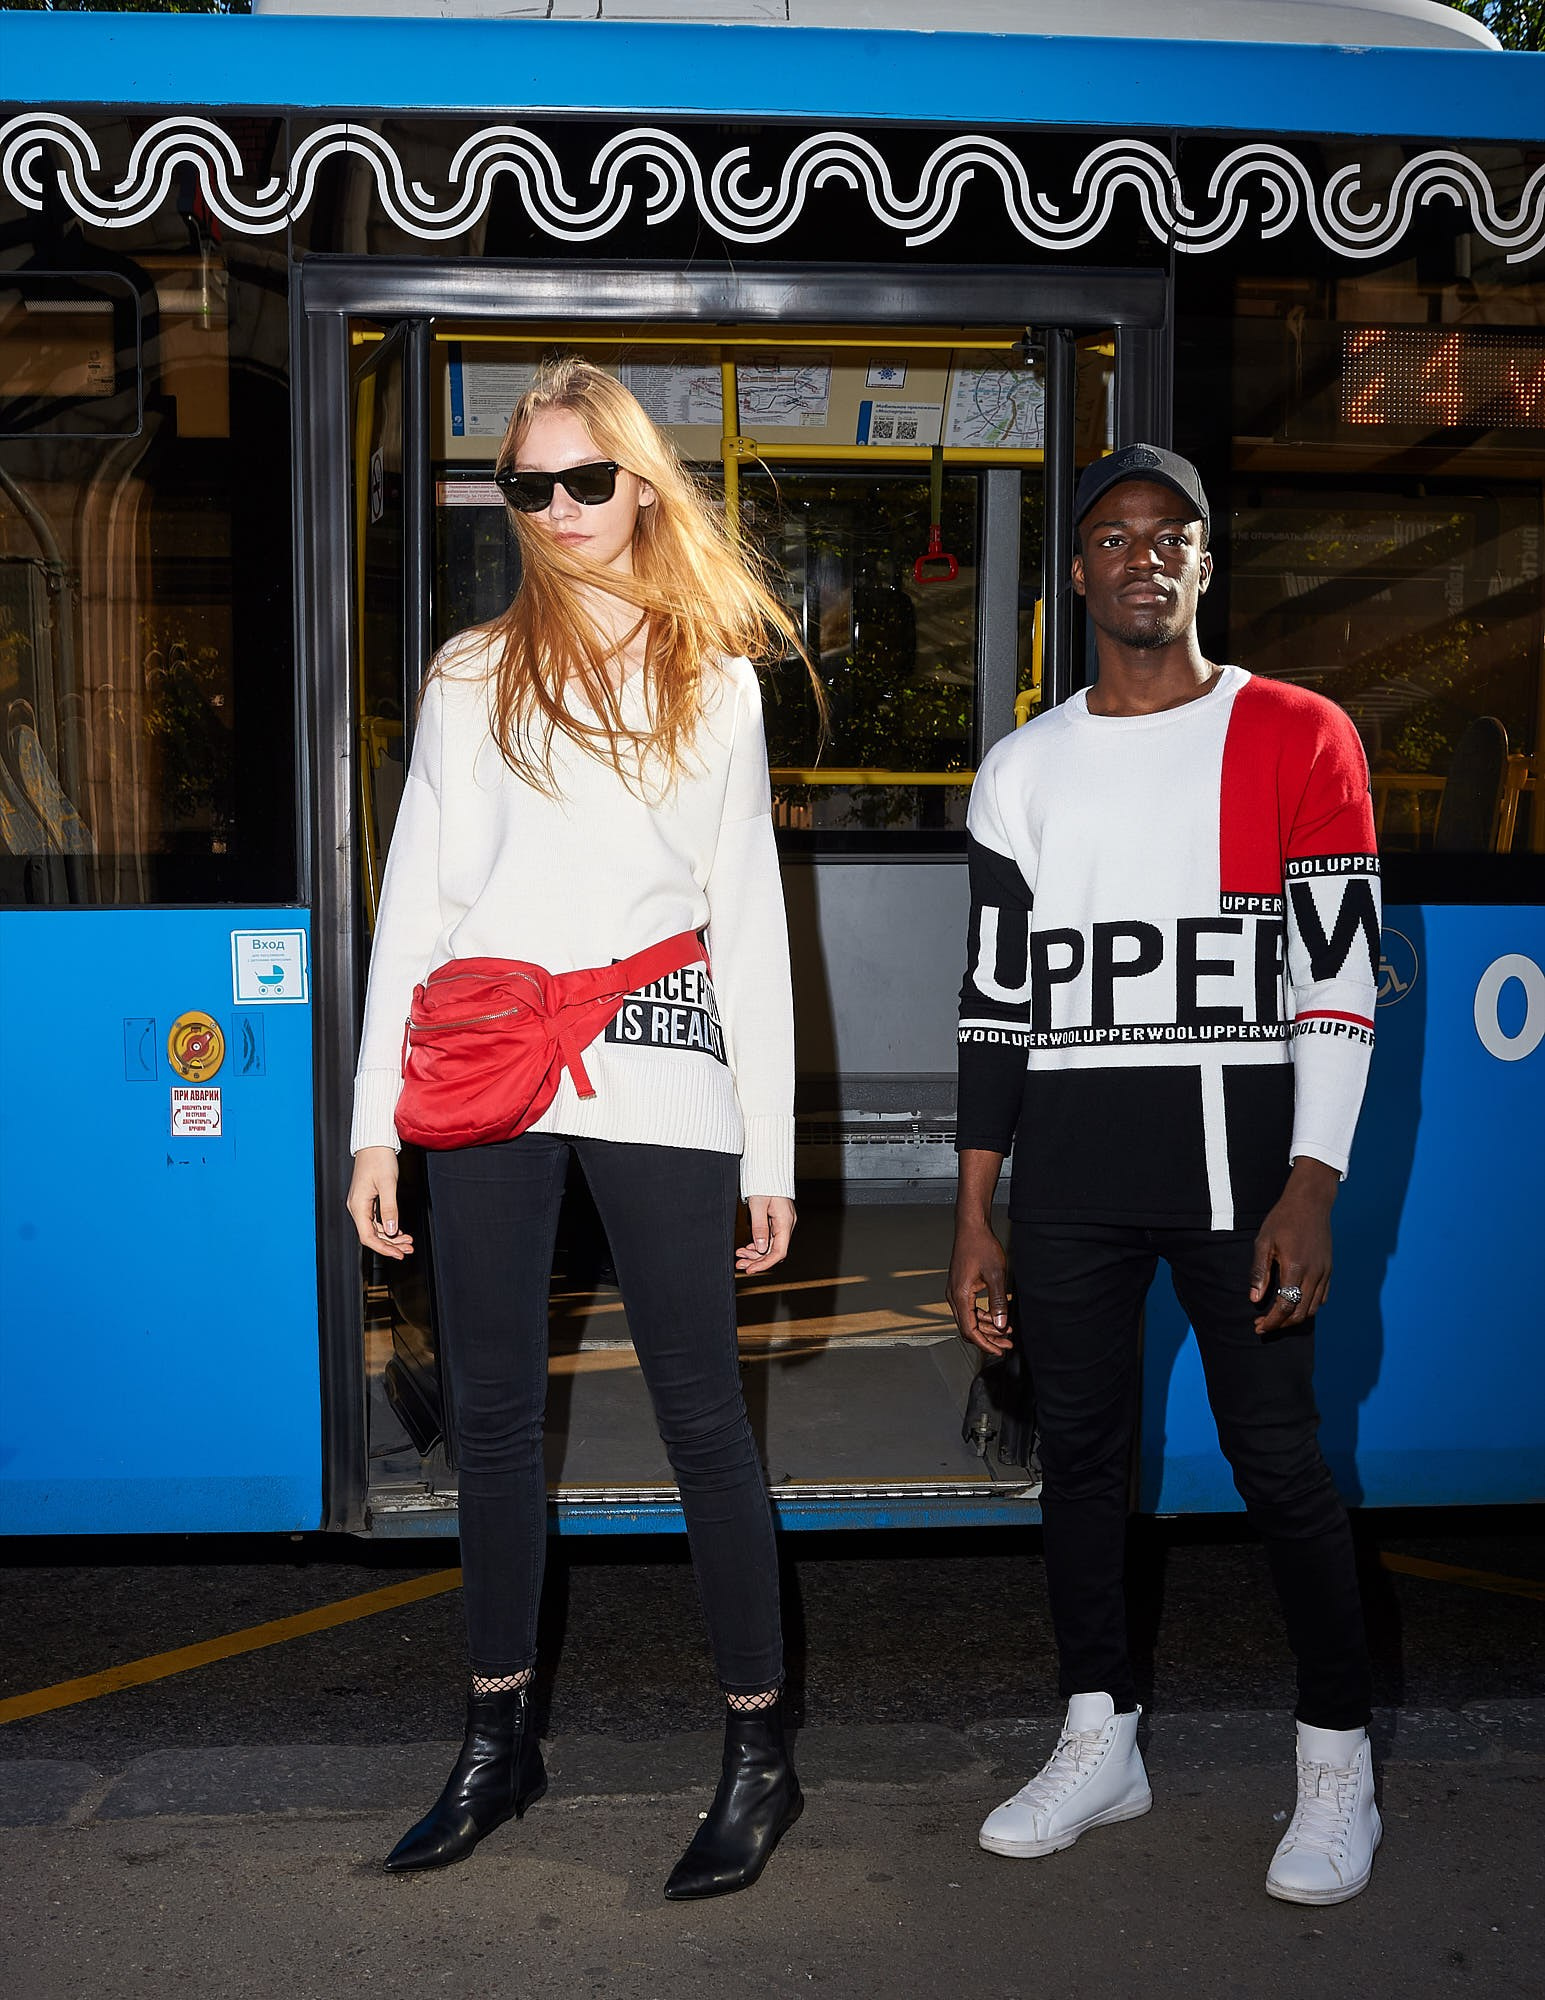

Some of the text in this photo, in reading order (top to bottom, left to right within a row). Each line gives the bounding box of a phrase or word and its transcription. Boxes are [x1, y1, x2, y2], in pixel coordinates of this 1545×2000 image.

[1349, 330, 1464, 426] 24
[1285, 856, 1380, 877] OOLUPPE
[1222, 895, 1282, 912] UPPER
[252, 939, 285, 950] Вход
[616, 1004, 643, 1041] IS
[174, 1089, 219, 1101] ПРИ АВАРИИ
